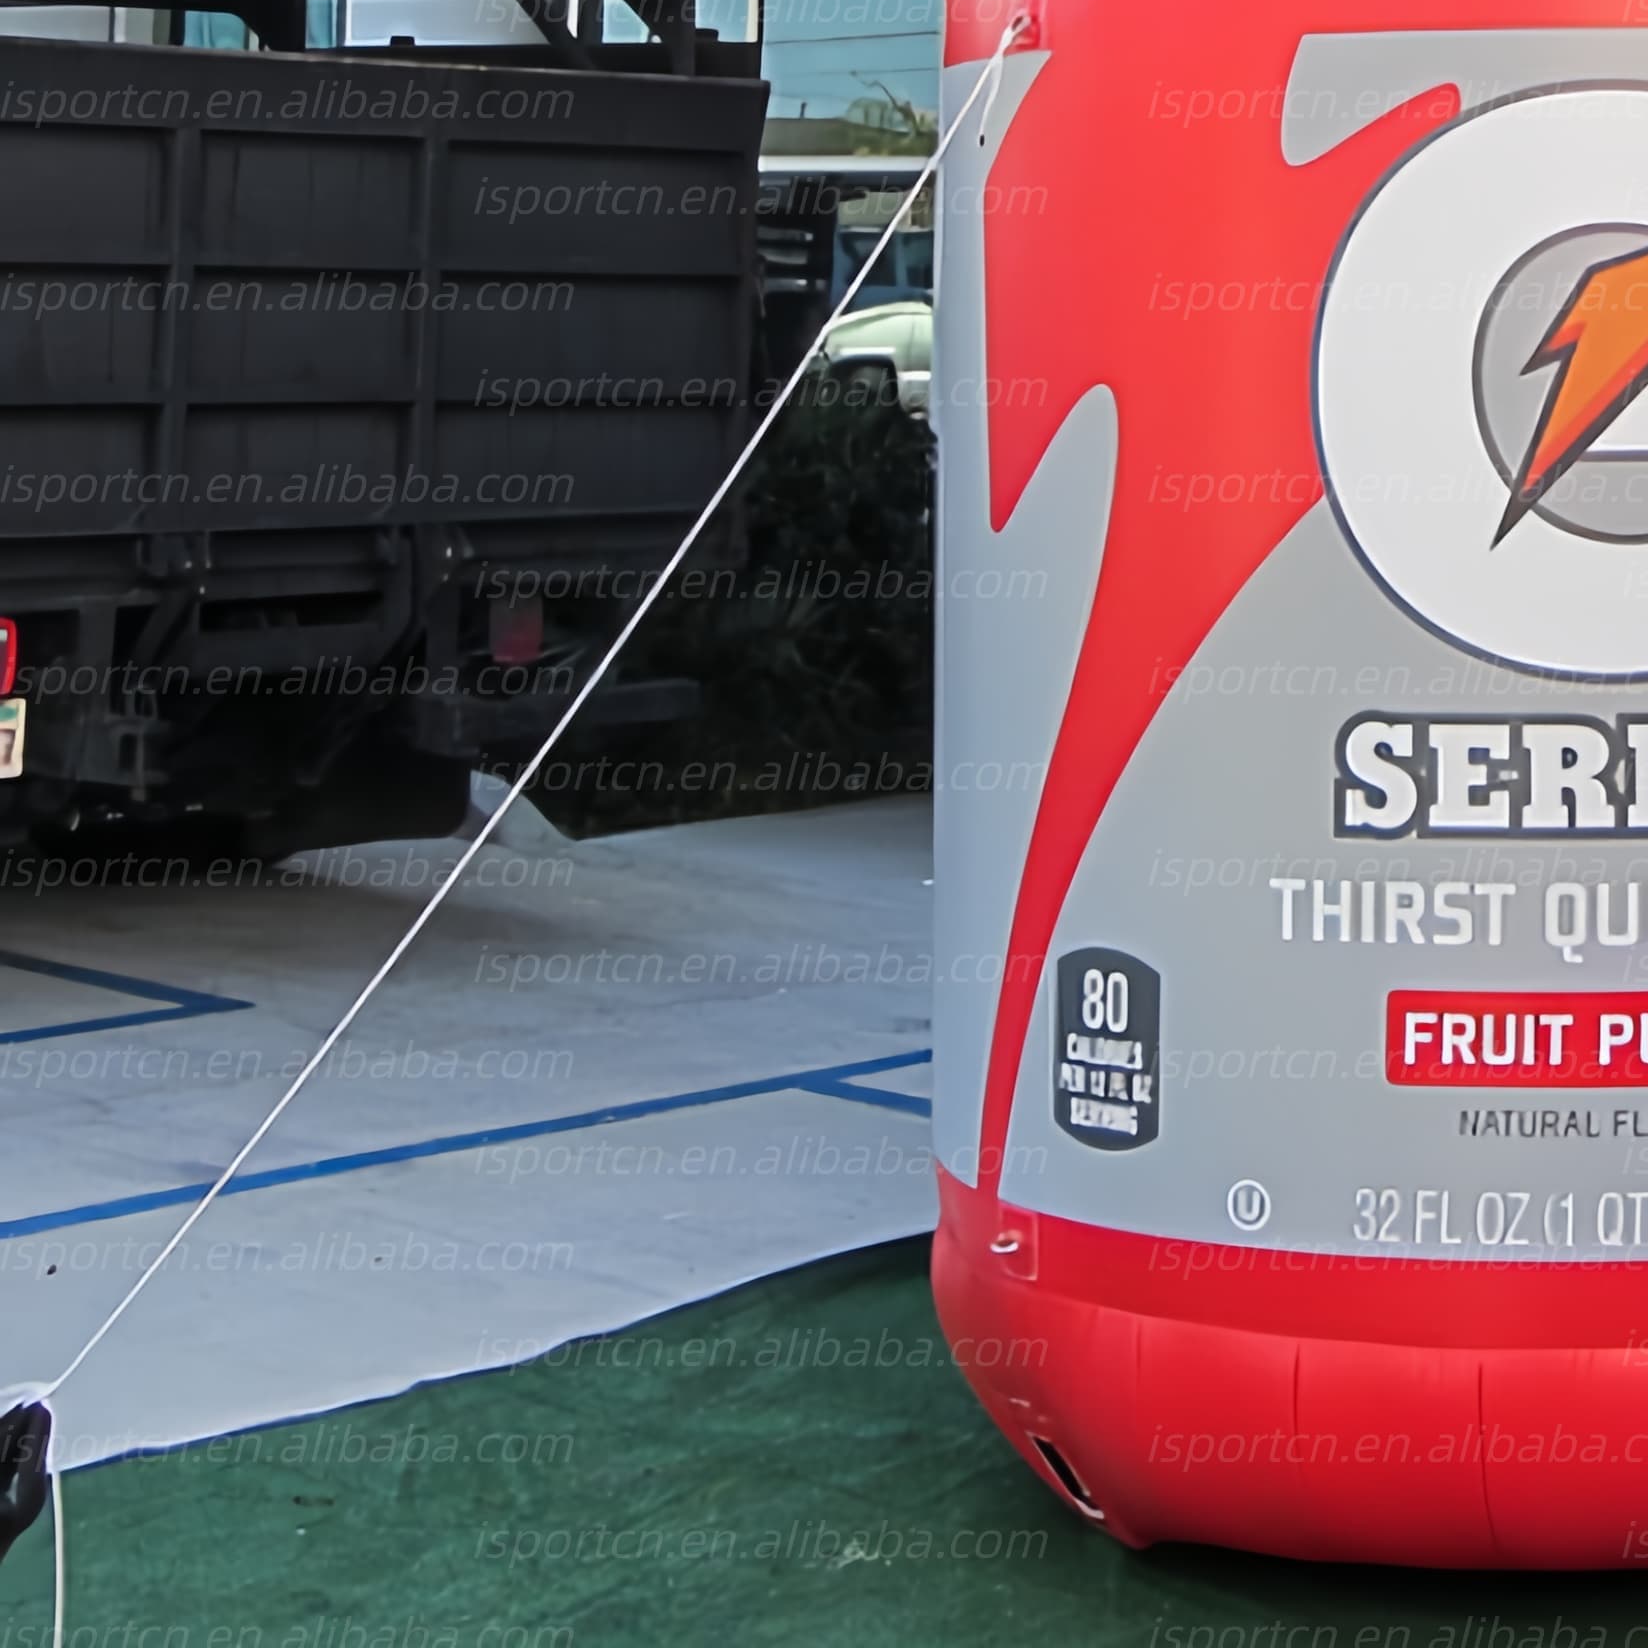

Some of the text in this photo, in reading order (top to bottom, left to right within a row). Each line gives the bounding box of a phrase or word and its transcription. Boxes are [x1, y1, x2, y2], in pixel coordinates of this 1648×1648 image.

[1269, 878, 1517, 945] THIRST
[1082, 968, 1128, 1033] 80
[1403, 1012, 1574, 1065] FRUIT
[1459, 1110, 1600, 1138] NATURAL
[1353, 1188, 1401, 1243] 32
[1414, 1190, 1461, 1245] FL
[1476, 1192, 1531, 1246] OZ
[1544, 1192, 1574, 1247] (1
